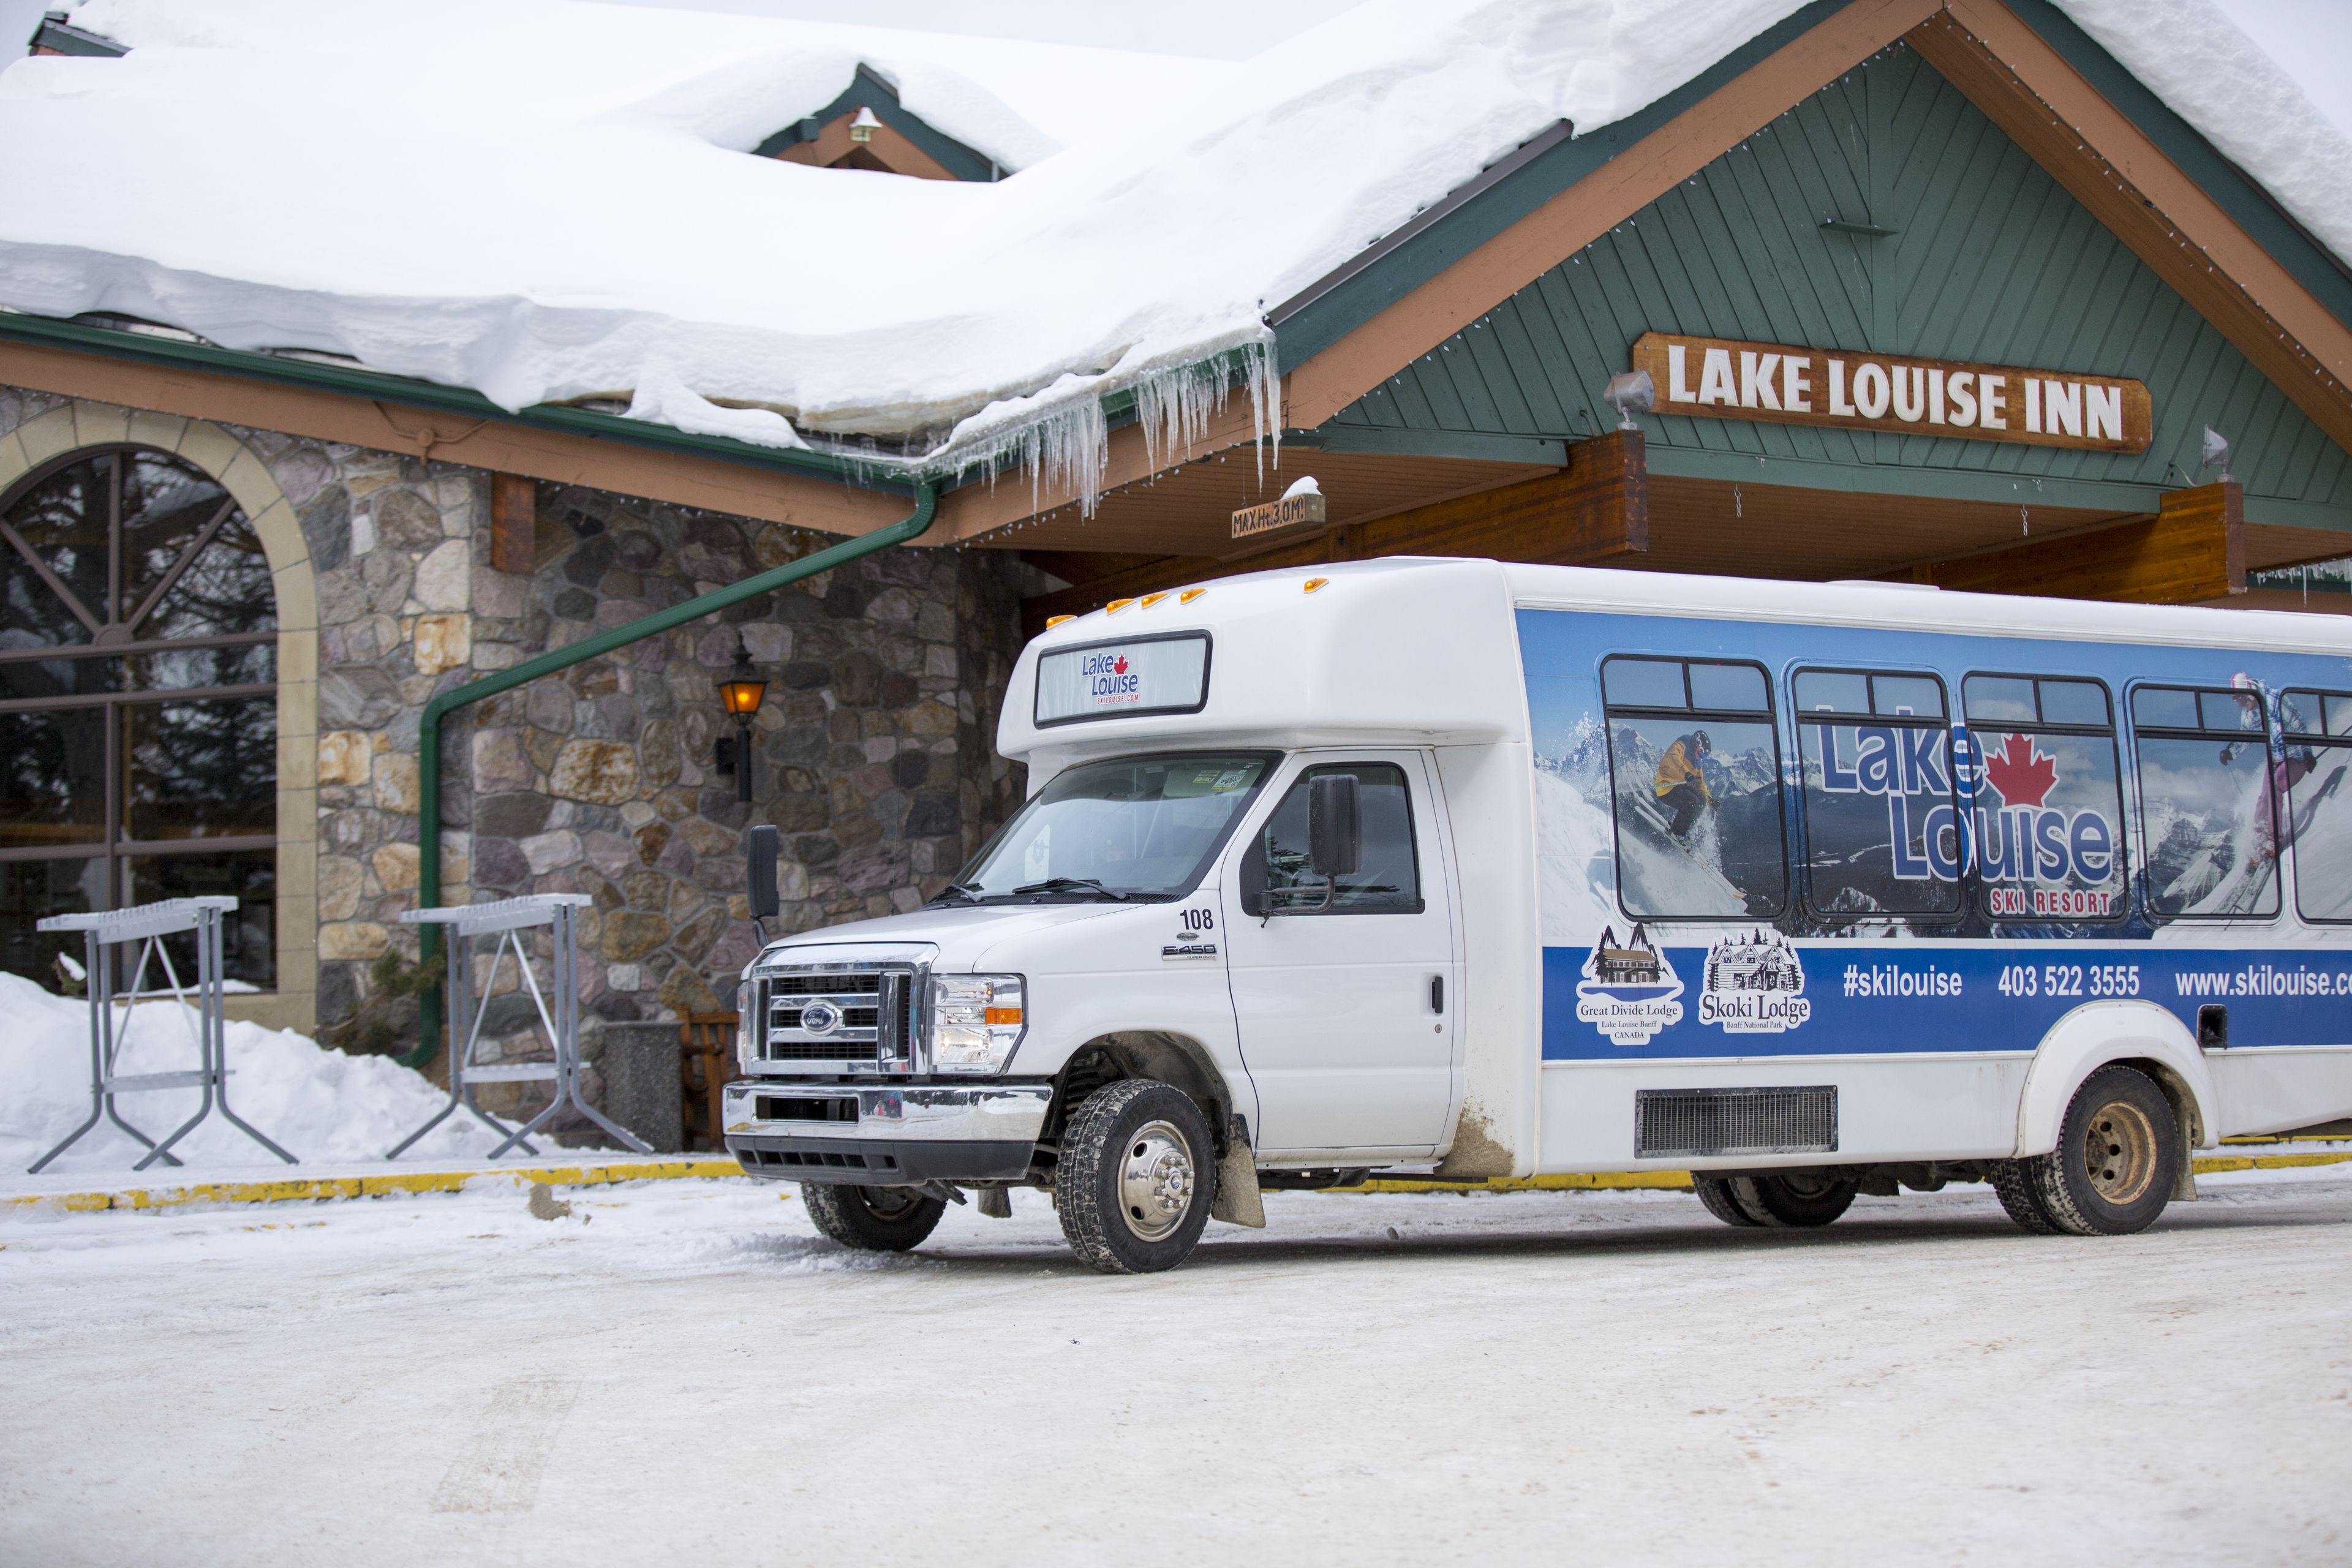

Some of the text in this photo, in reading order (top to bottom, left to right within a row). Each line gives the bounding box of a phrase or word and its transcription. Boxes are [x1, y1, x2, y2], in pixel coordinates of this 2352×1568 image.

[1668, 345, 2122, 442] LAKE LOUISE INN
[1082, 653, 1114, 676] Lake
[1091, 674, 1138, 696] Louise
[1097, 694, 1139, 704] SKILOUISE.COM
[1817, 705, 1986, 798] Lake
[1888, 792, 2114, 884] Louise
[1989, 888, 2112, 917] SKI RESORT
[1180, 909, 1213, 930] 108
[1843, 964, 1962, 997] #skilouise
[1997, 965, 2140, 997] 403 522 3555
[807, 1010, 824, 1025] Ford
[1580, 1005, 1678, 1019] Great Divide Lodge
[1702, 995, 1807, 1023] Skoki Lodge
[1770, 1020, 1783, 1029] Park
